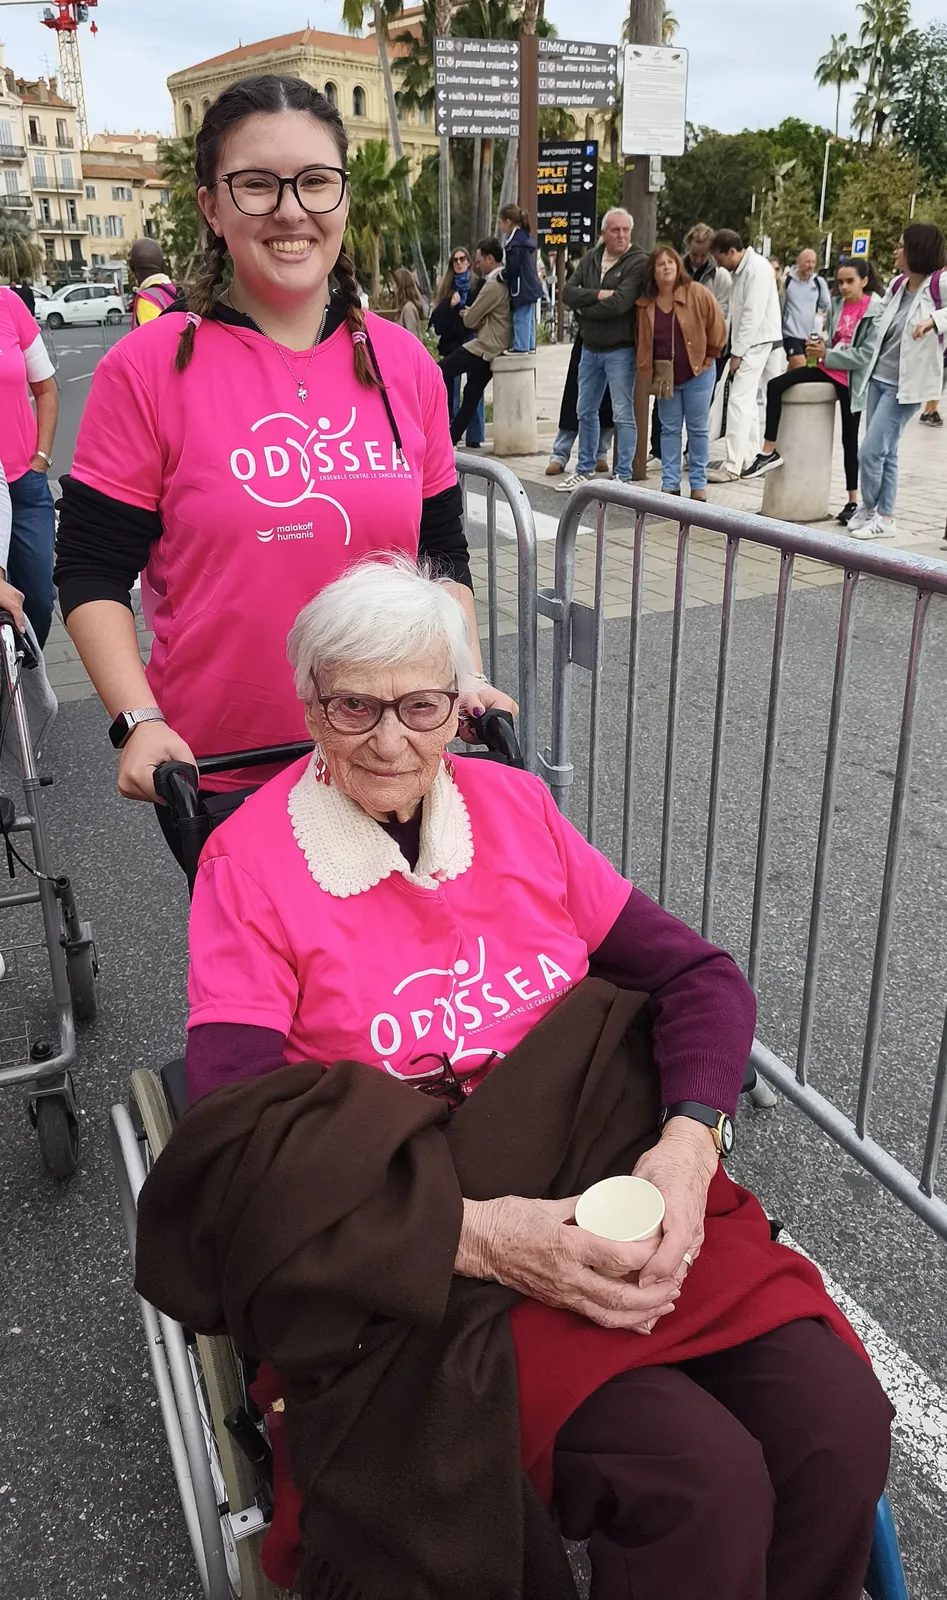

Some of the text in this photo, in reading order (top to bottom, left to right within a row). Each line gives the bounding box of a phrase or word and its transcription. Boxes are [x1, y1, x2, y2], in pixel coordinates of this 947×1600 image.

[464, 42, 480, 53] palais
[487, 43, 509, 53] festivals
[548, 41, 596, 56] hôtel de ville
[455, 58, 509, 70] promenade croisette
[579, 64, 584, 72] de
[586, 64, 590, 72] la
[556, 79, 605, 89] marché forville
[466, 92, 477, 100] ville
[478, 93, 483, 101] le
[557, 94, 594, 106] meynadier
[451, 108, 509, 119] police municipale
[452, 124, 509, 135] gare des autobus
[542, 145, 594, 156] INFORMATION P
[857, 241, 864, 252] P
[230, 430, 410, 482] ODYSSEA
[277, 522, 313, 532] malakoff
[278, 531, 313, 541] humanis
[370, 953, 572, 1055] ODYSSEA
[502, 1007, 525, 1020] CONTRE
[534, 994, 554, 1006] CANCER
[556, 990, 562, 998] DU
